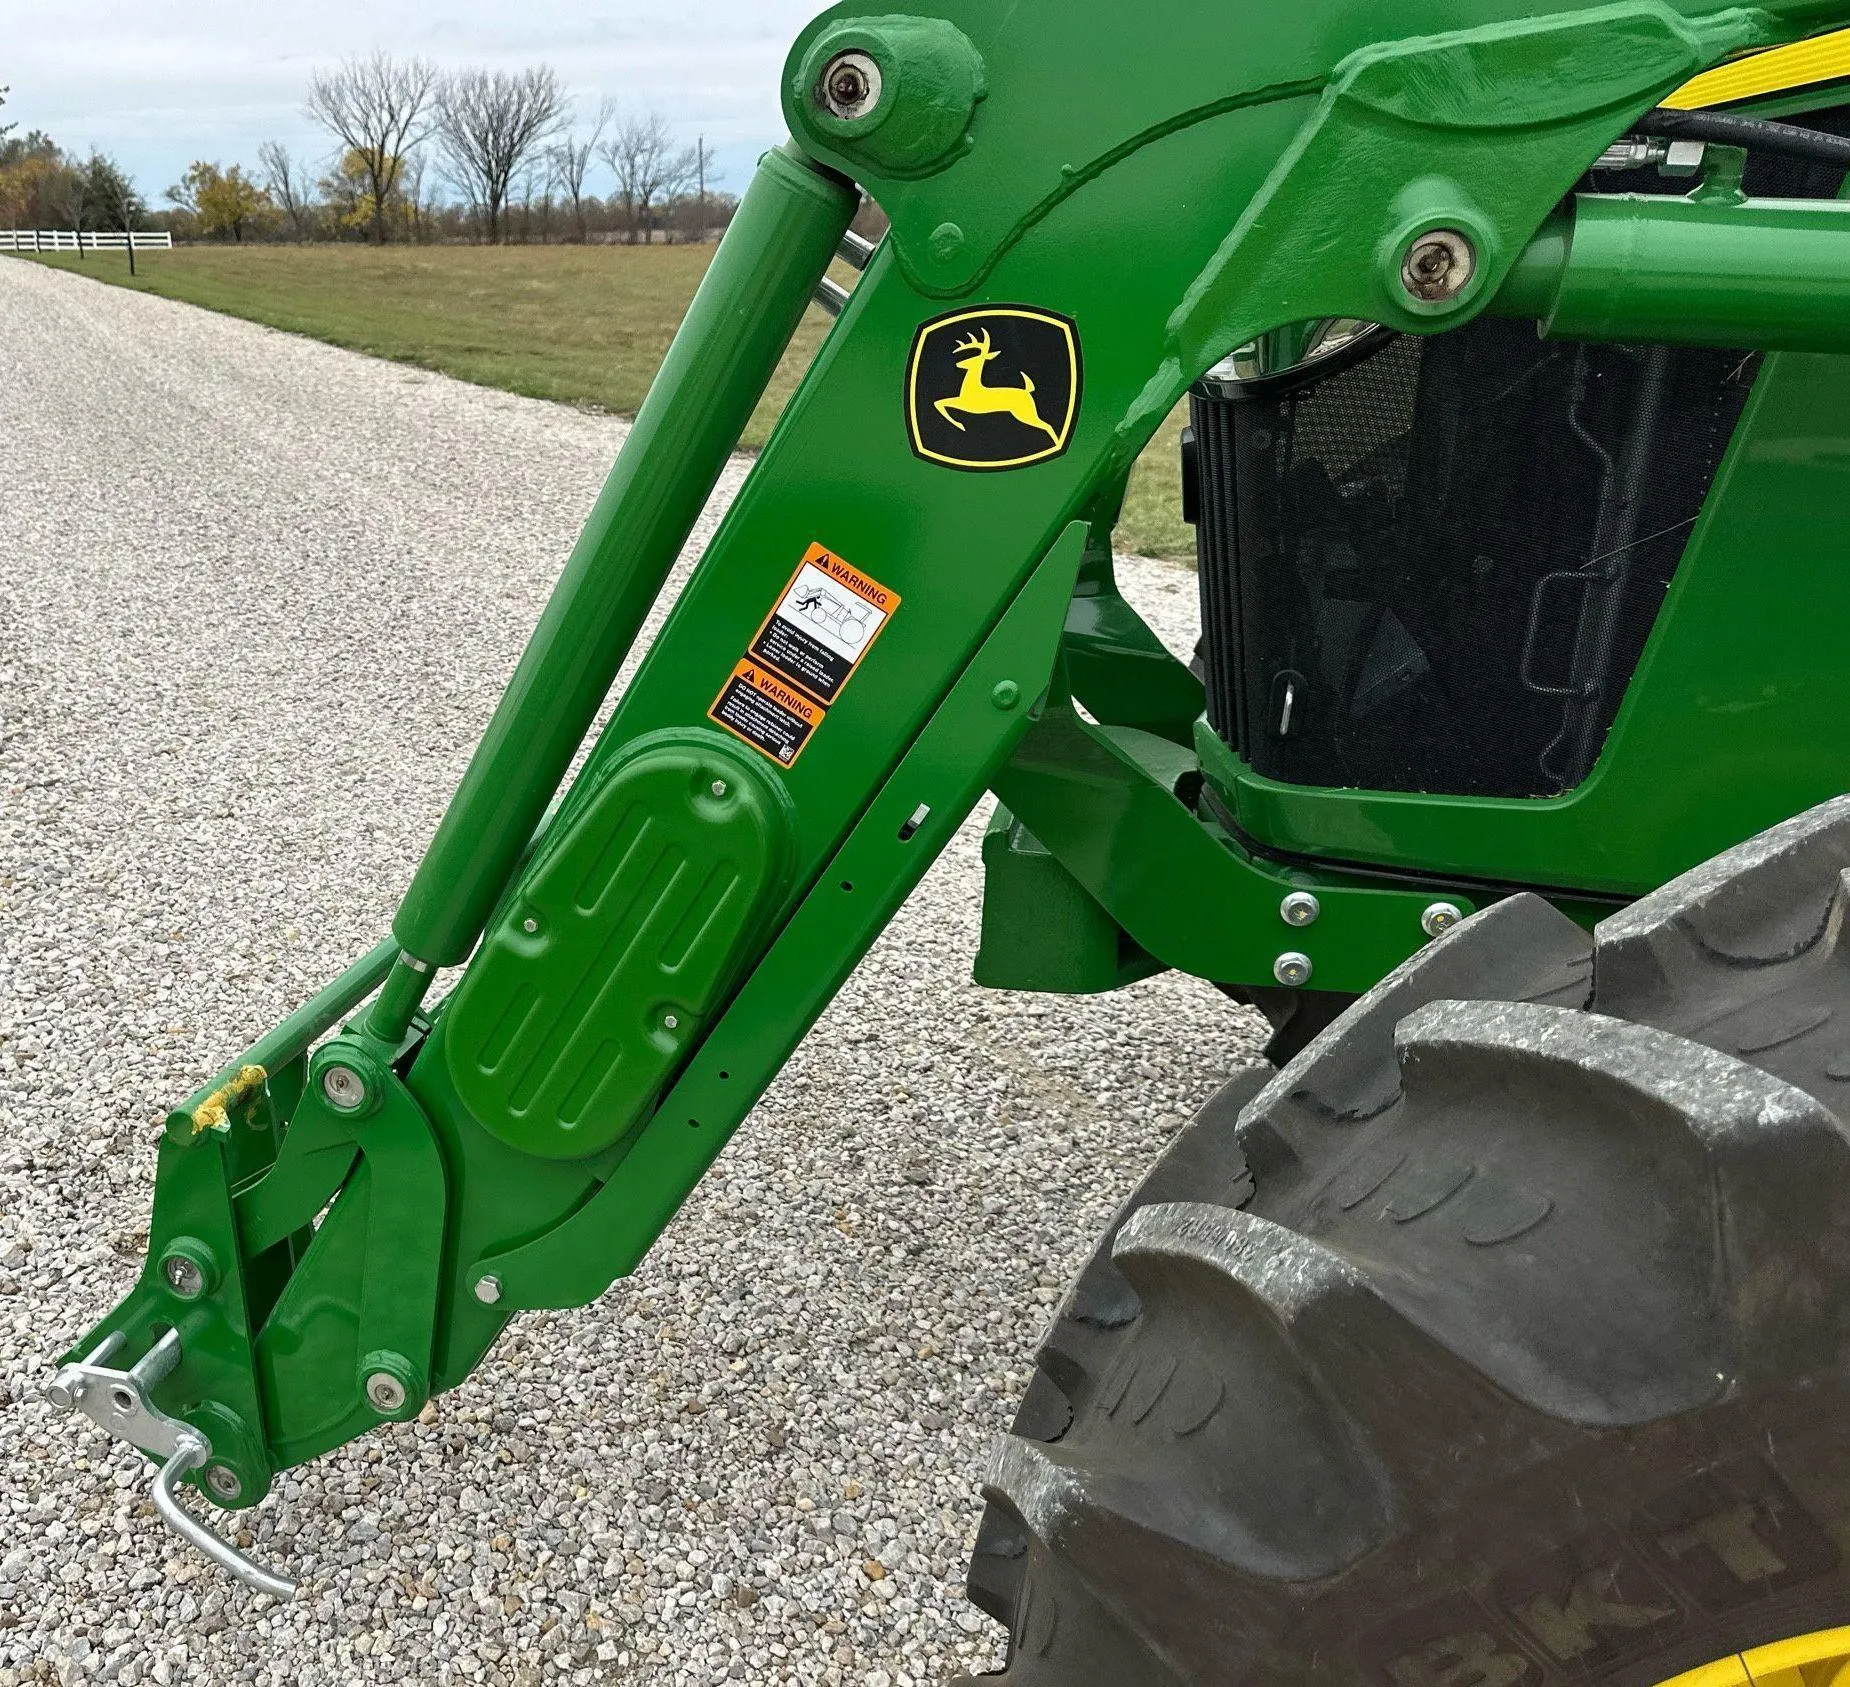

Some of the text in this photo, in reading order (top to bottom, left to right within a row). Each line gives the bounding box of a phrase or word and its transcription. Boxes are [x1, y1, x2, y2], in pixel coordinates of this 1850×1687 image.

[829, 561, 888, 605] WARNING
[778, 636, 788, 645] not
[780, 623, 795, 635] avoid
[793, 632, 808, 644] injury
[807, 640, 820, 651] from
[818, 648, 835, 662] falling
[779, 652, 796, 664] loader
[785, 648, 800, 660] under
[737, 682, 746, 691] DO
[745, 687, 756, 697] NOT
[757, 677, 814, 719] WARNING
